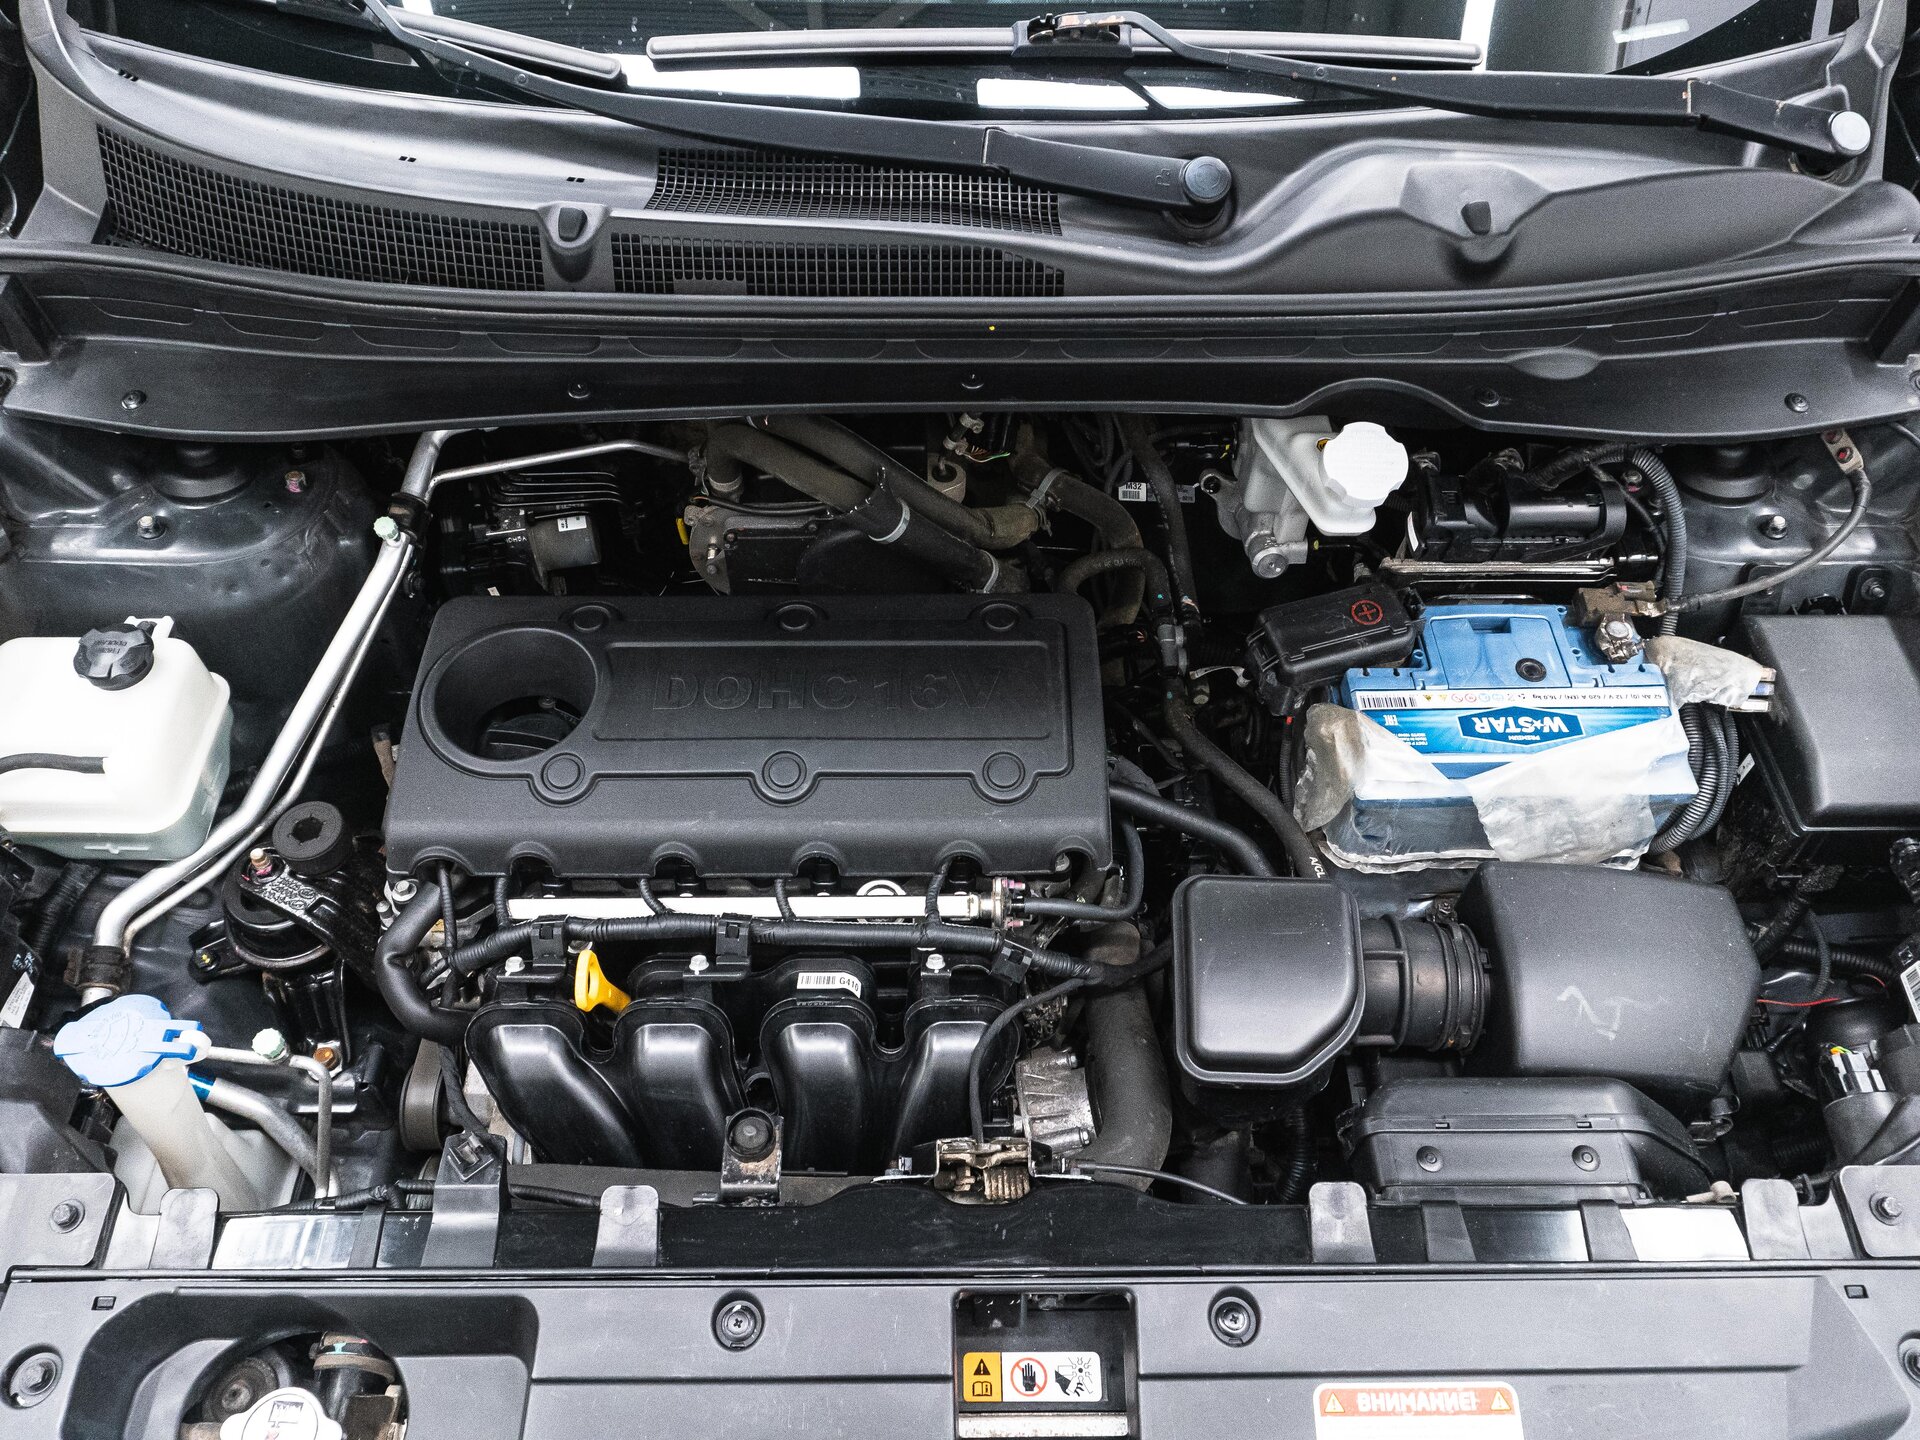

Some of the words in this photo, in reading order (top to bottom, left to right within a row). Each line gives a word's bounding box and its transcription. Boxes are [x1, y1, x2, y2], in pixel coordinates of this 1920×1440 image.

[1125, 482, 1142, 490] M32
[652, 671, 858, 711] DOHC
[872, 667, 1002, 710] 16V
[840, 977, 859, 991] G410
